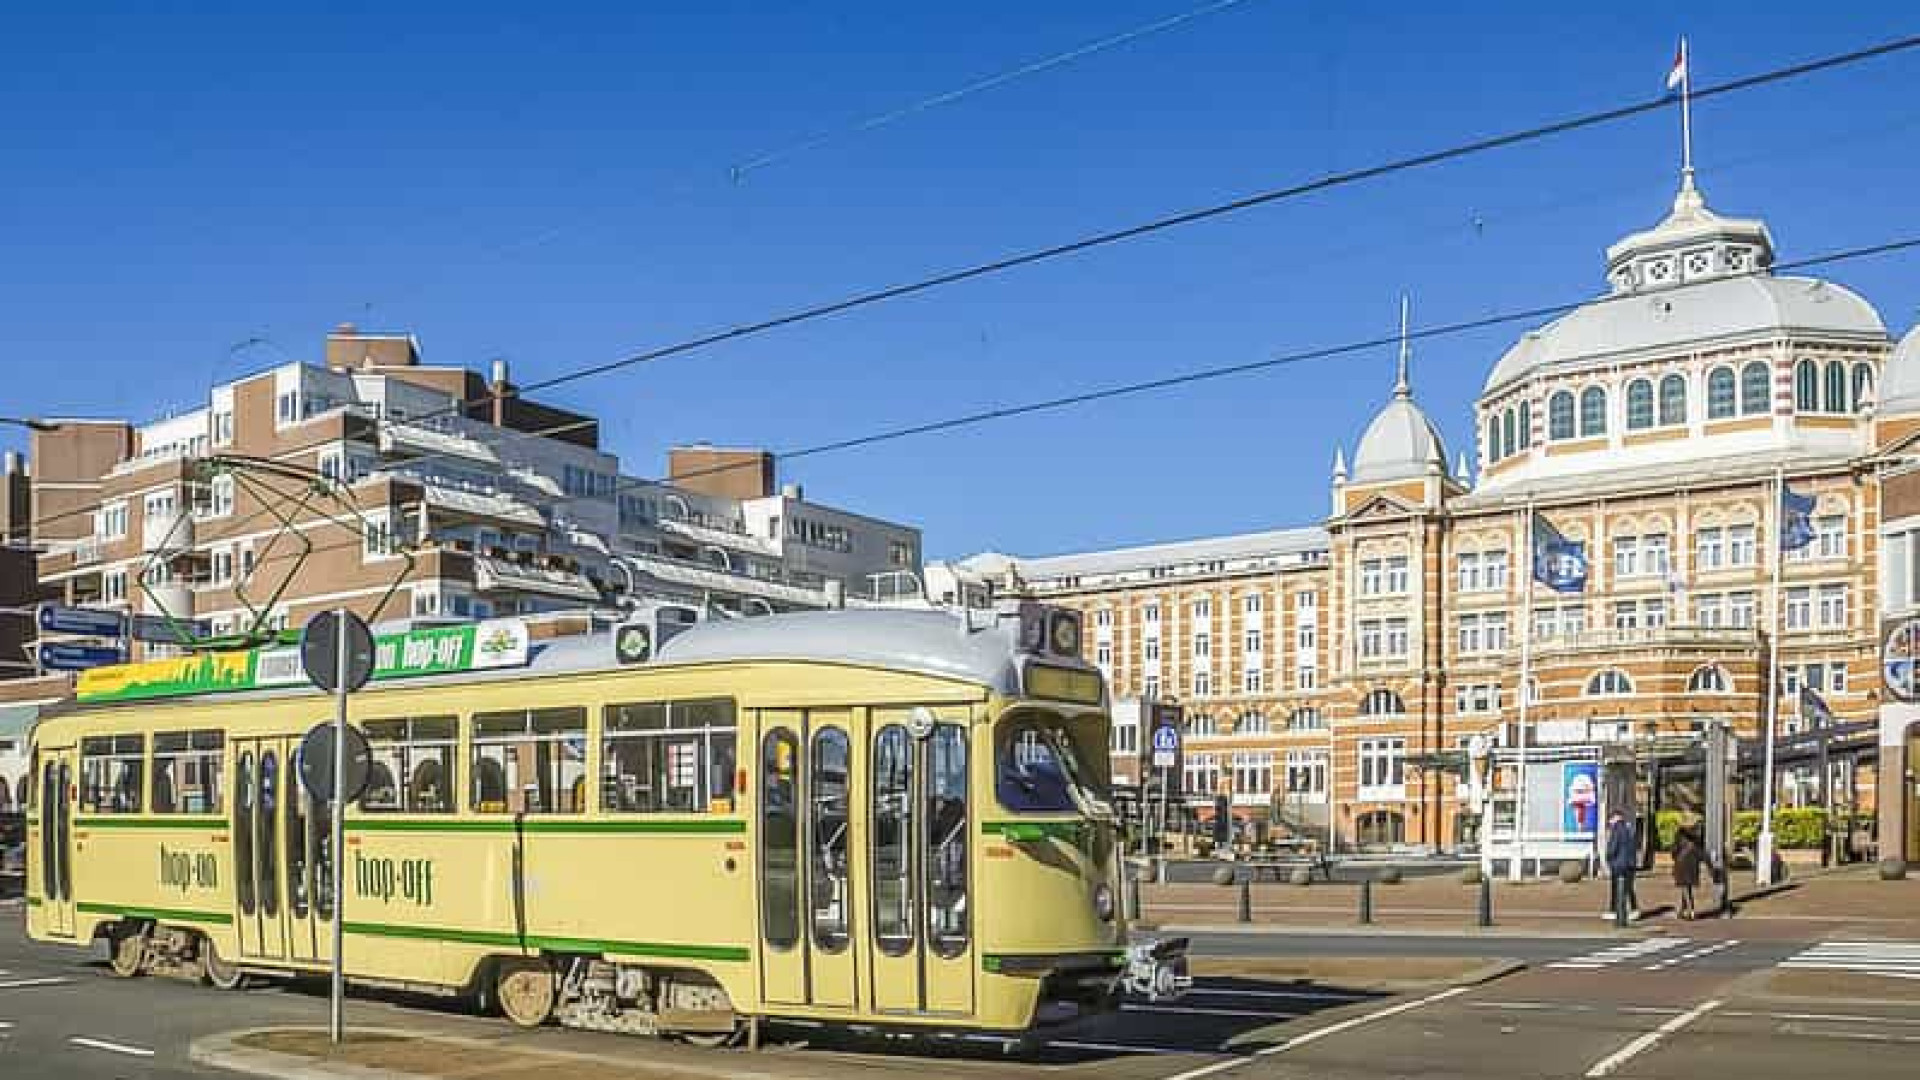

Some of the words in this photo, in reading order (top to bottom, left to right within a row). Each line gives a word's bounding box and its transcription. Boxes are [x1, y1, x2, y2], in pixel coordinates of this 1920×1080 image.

[403, 633, 463, 670] hop-off
[160, 842, 217, 893] hop-on
[355, 848, 432, 907] hop-off
